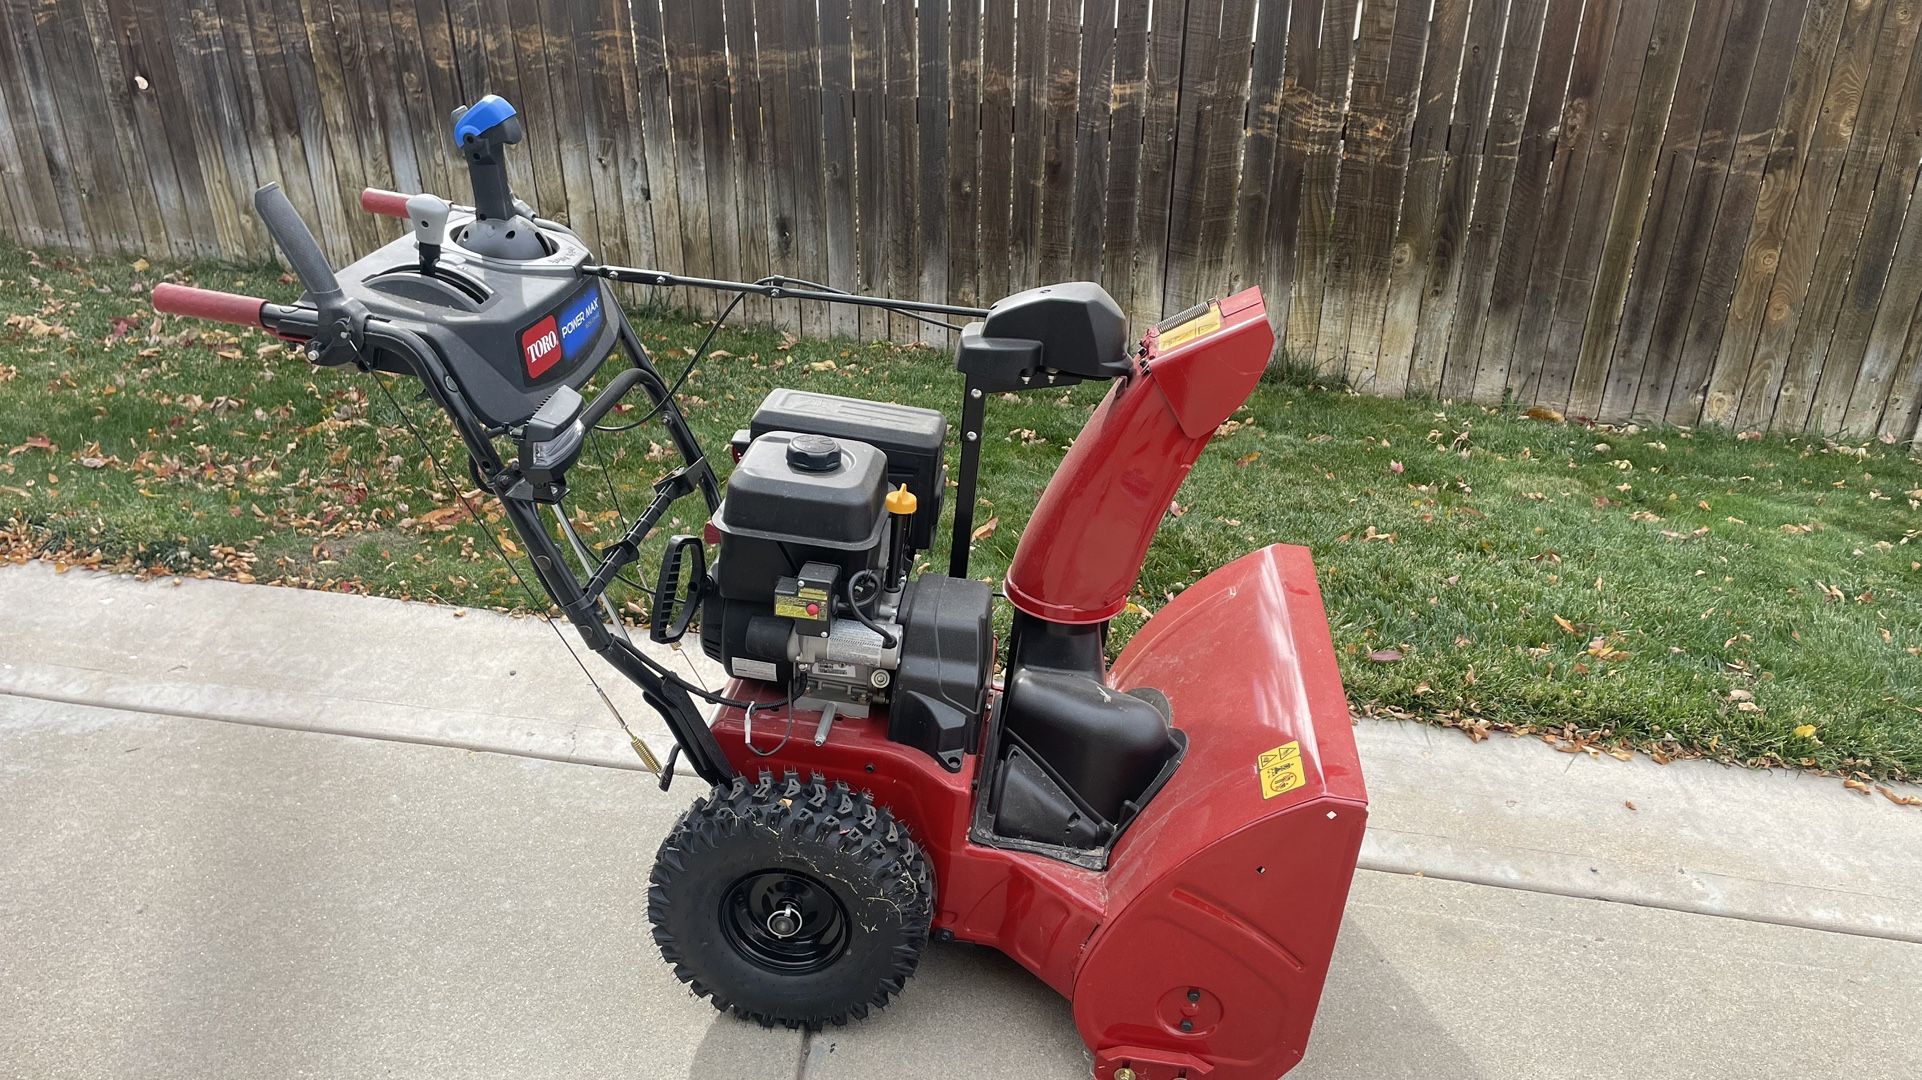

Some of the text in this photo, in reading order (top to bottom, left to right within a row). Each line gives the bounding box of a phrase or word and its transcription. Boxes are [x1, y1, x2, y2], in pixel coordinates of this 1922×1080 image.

[561, 311, 585, 339] POWER
[585, 297, 599, 319] MAX
[527, 330, 557, 363] TORO
